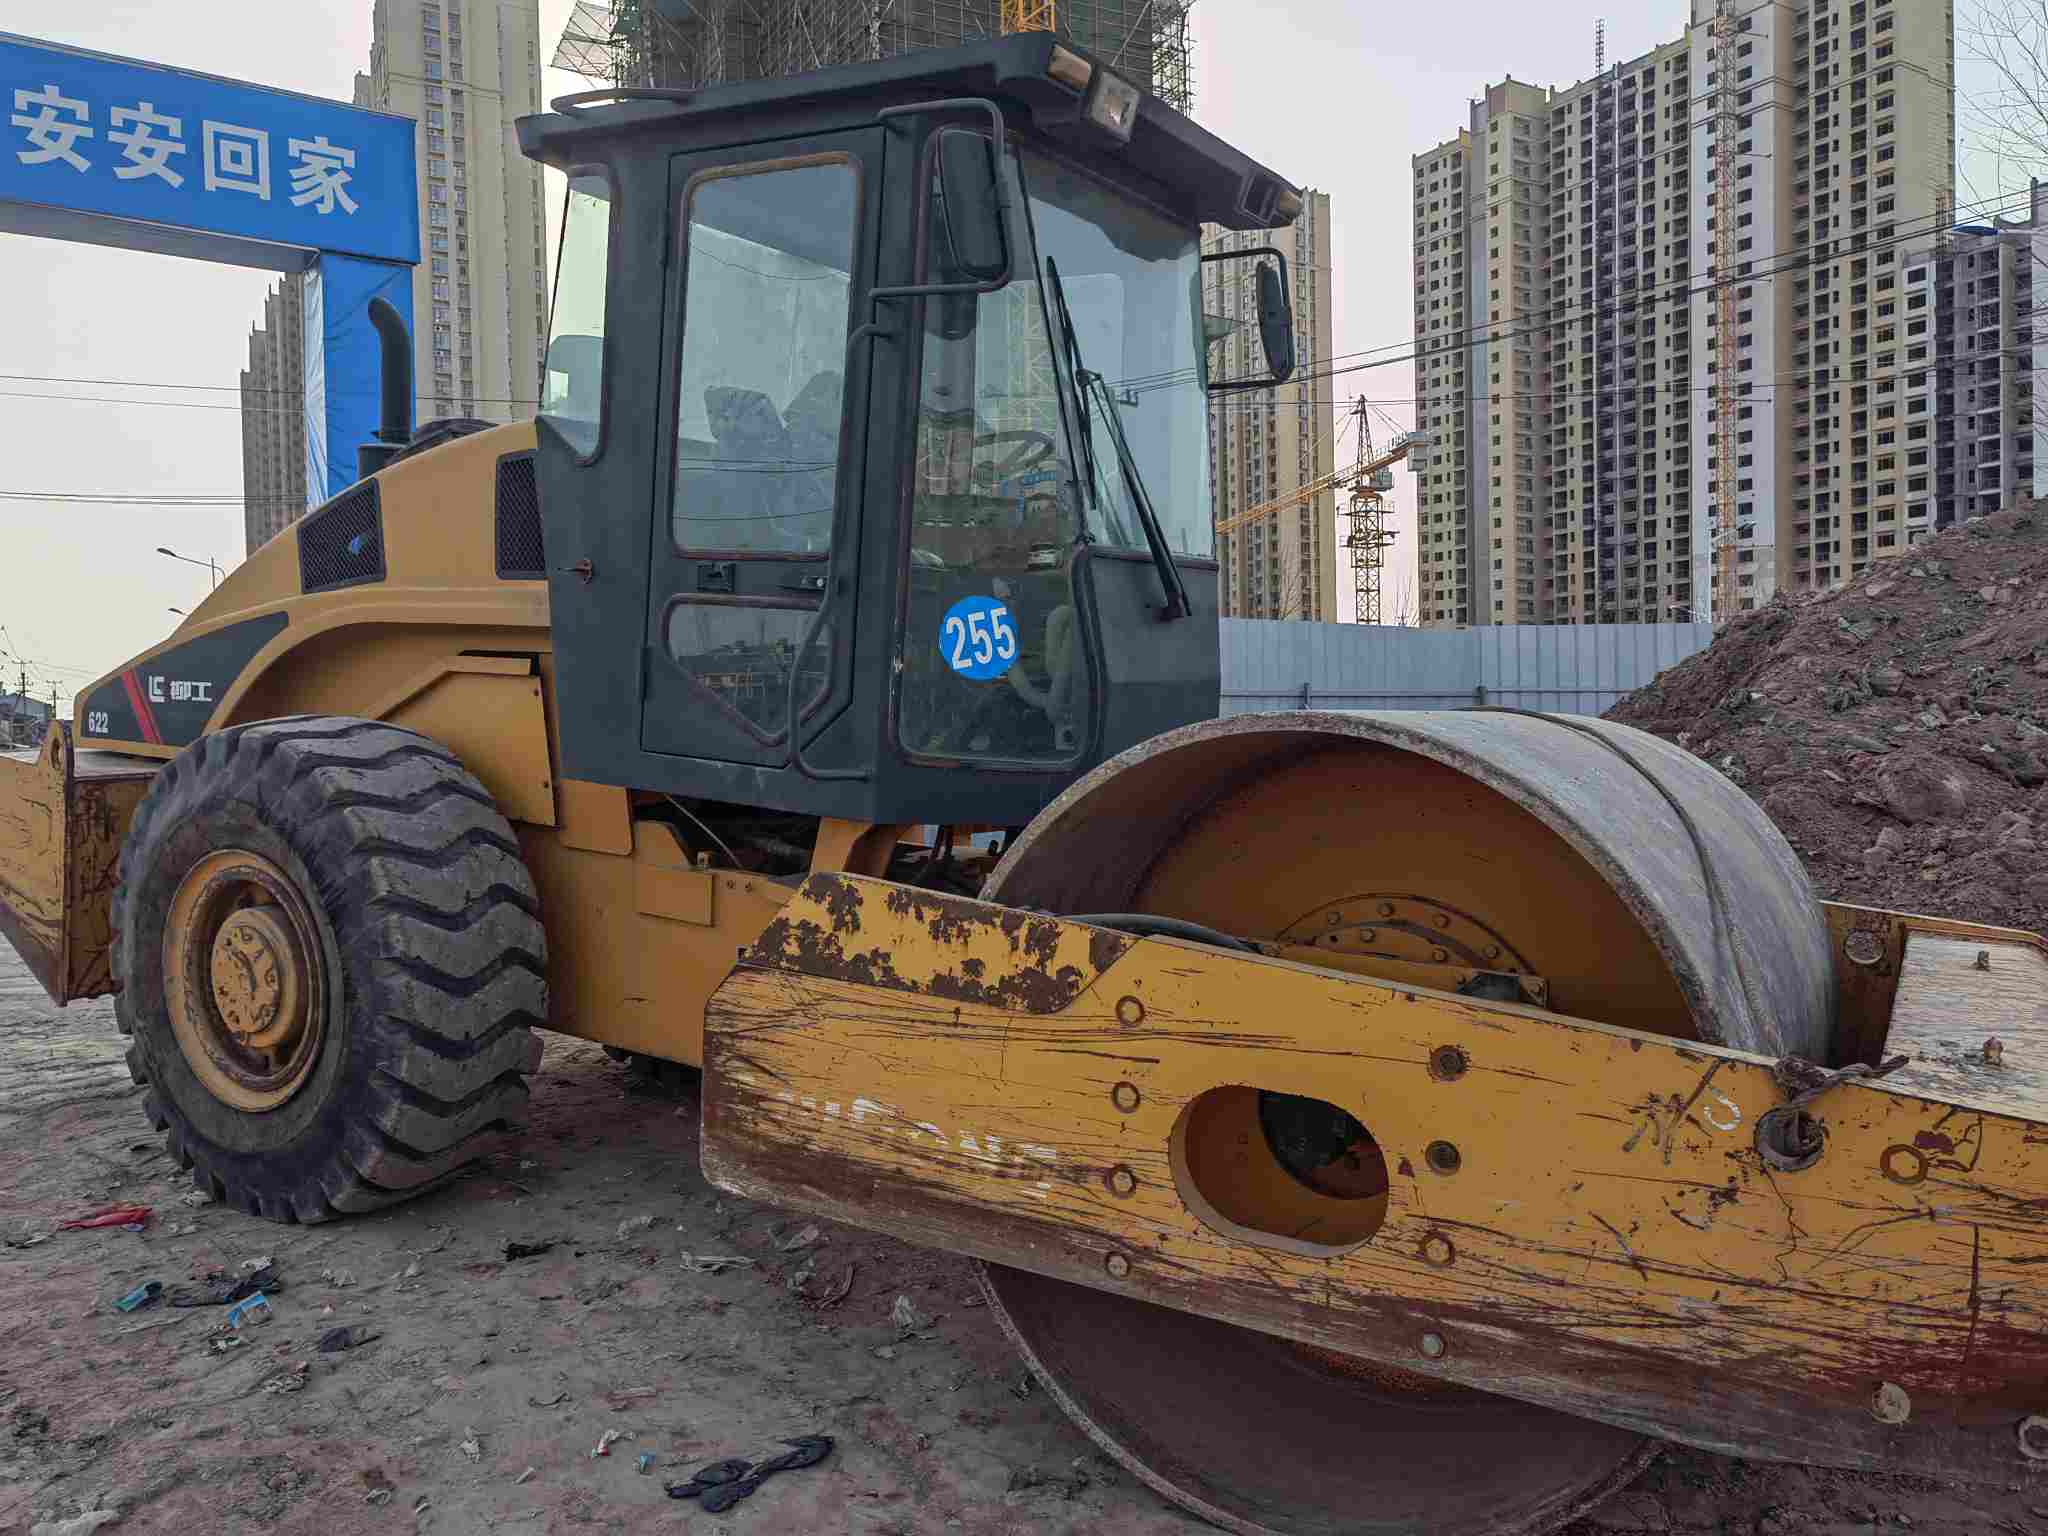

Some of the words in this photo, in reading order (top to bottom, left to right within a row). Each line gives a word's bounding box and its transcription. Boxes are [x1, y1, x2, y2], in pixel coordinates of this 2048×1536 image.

[11, 84, 359, 215] 安安回家
[945, 607, 1015, 670] 255
[88, 711, 109, 734] 622
